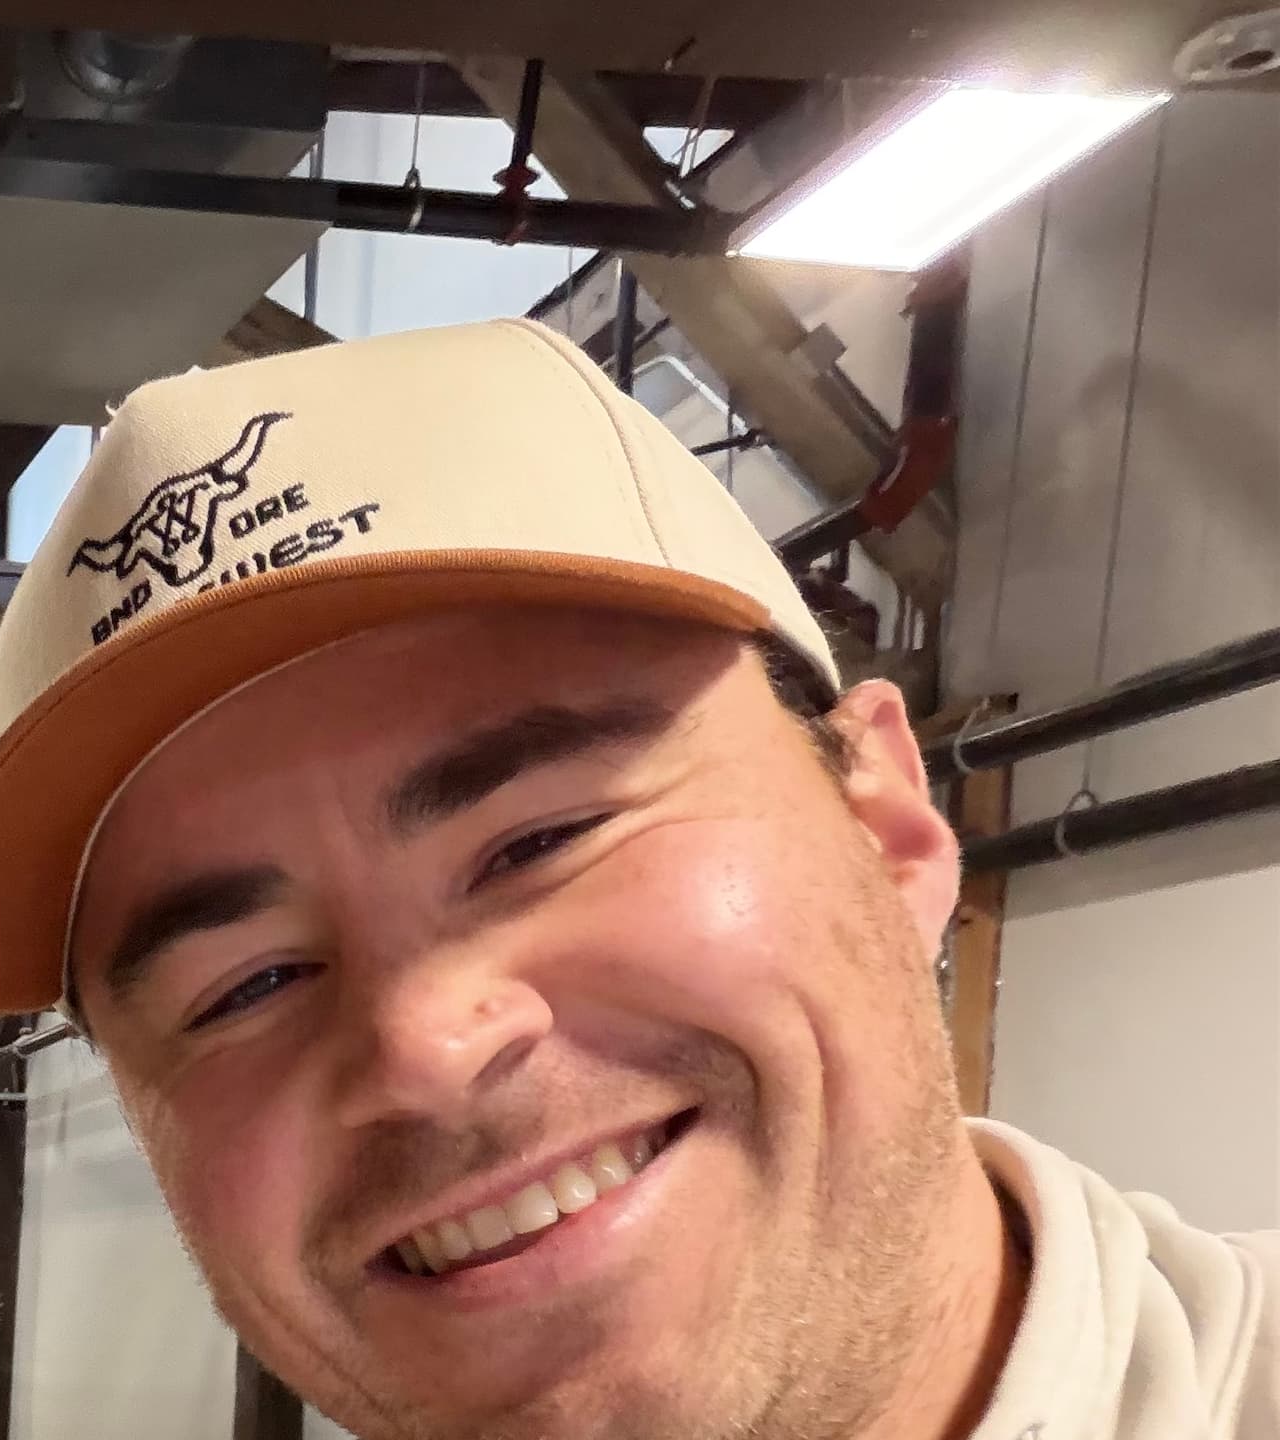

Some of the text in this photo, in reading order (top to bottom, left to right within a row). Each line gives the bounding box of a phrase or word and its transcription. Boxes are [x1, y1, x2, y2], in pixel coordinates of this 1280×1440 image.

[91, 483, 310, 646] BND ORE
[197, 502, 381, 593] WEST
